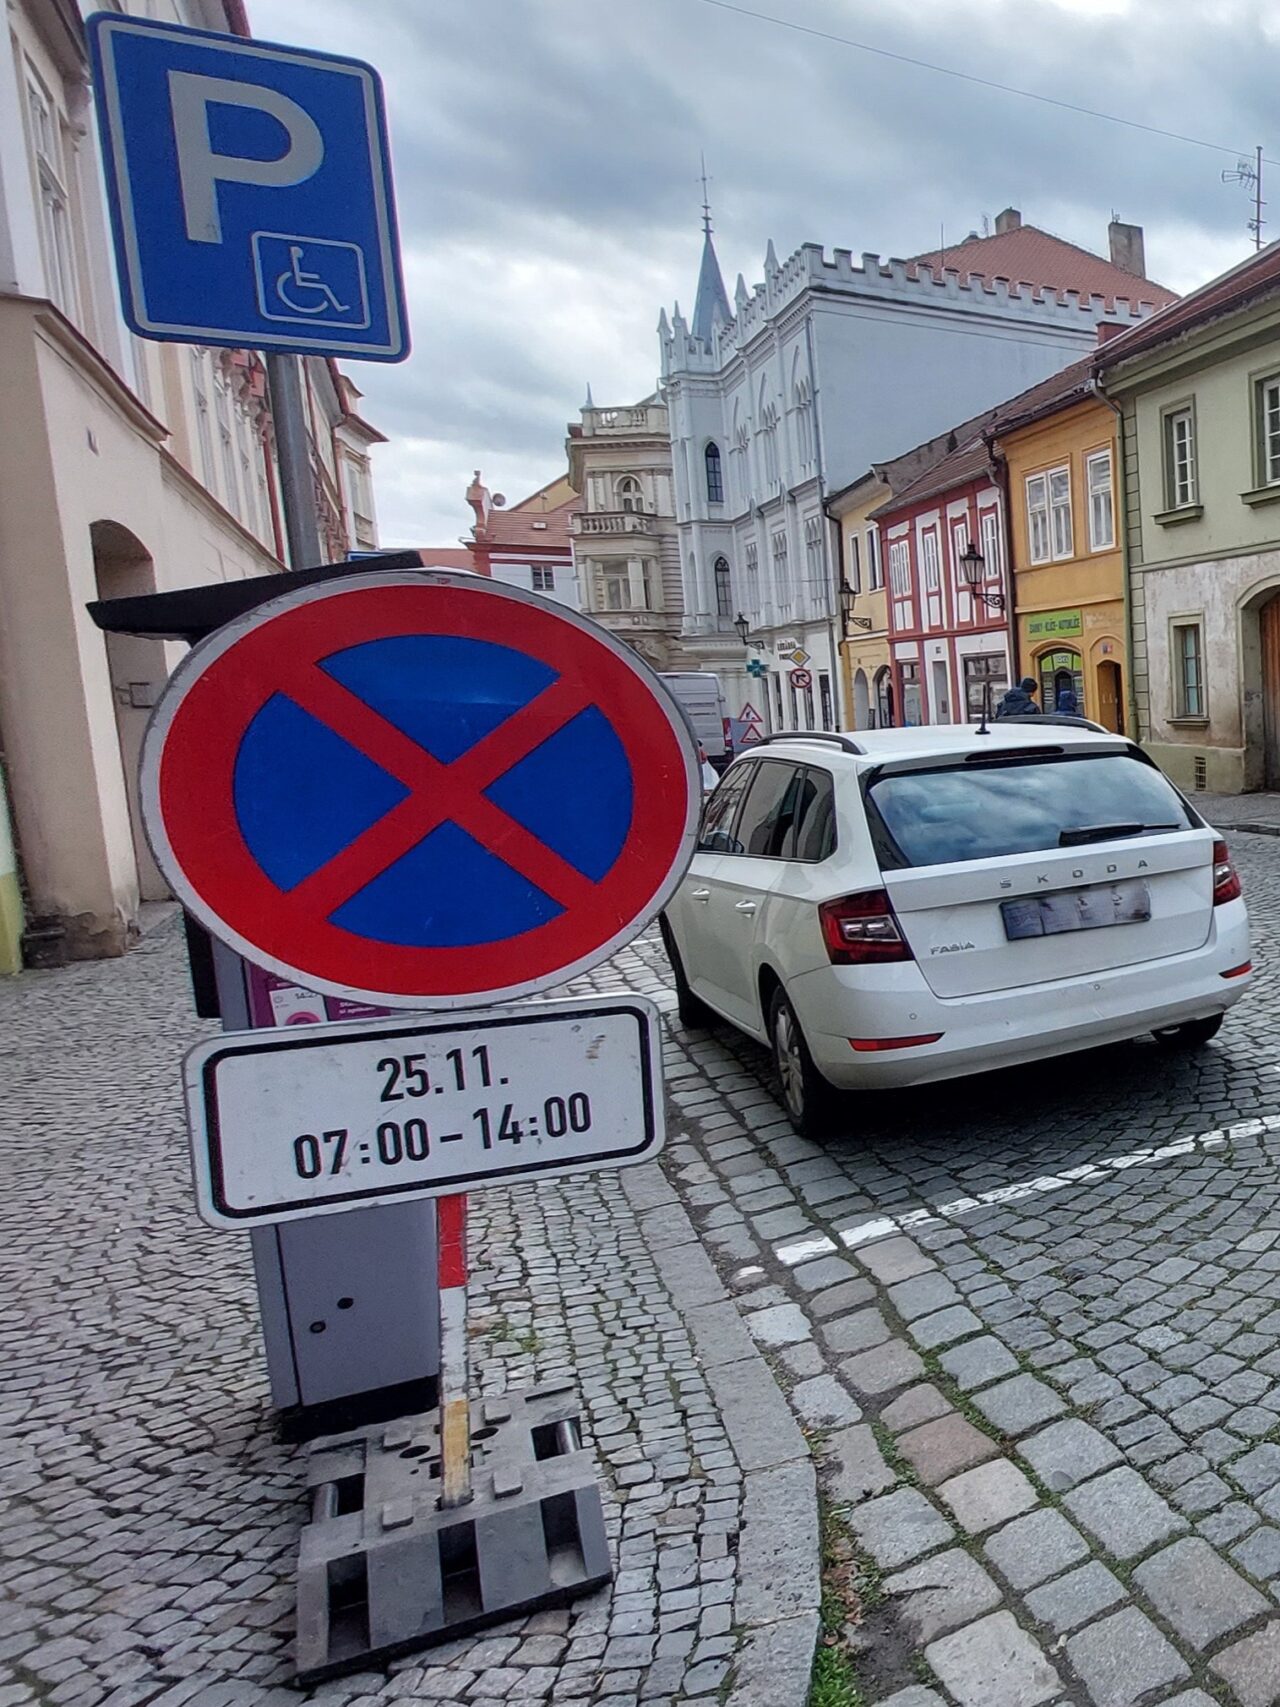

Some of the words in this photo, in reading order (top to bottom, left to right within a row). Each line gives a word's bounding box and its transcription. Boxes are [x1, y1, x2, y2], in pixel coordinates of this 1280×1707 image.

[167, 69, 325, 245] P
[1000, 859, 1148, 889] ŠKODA
[930, 942, 975, 955] FABIA
[376, 1045, 509, 1102] 25.11.
